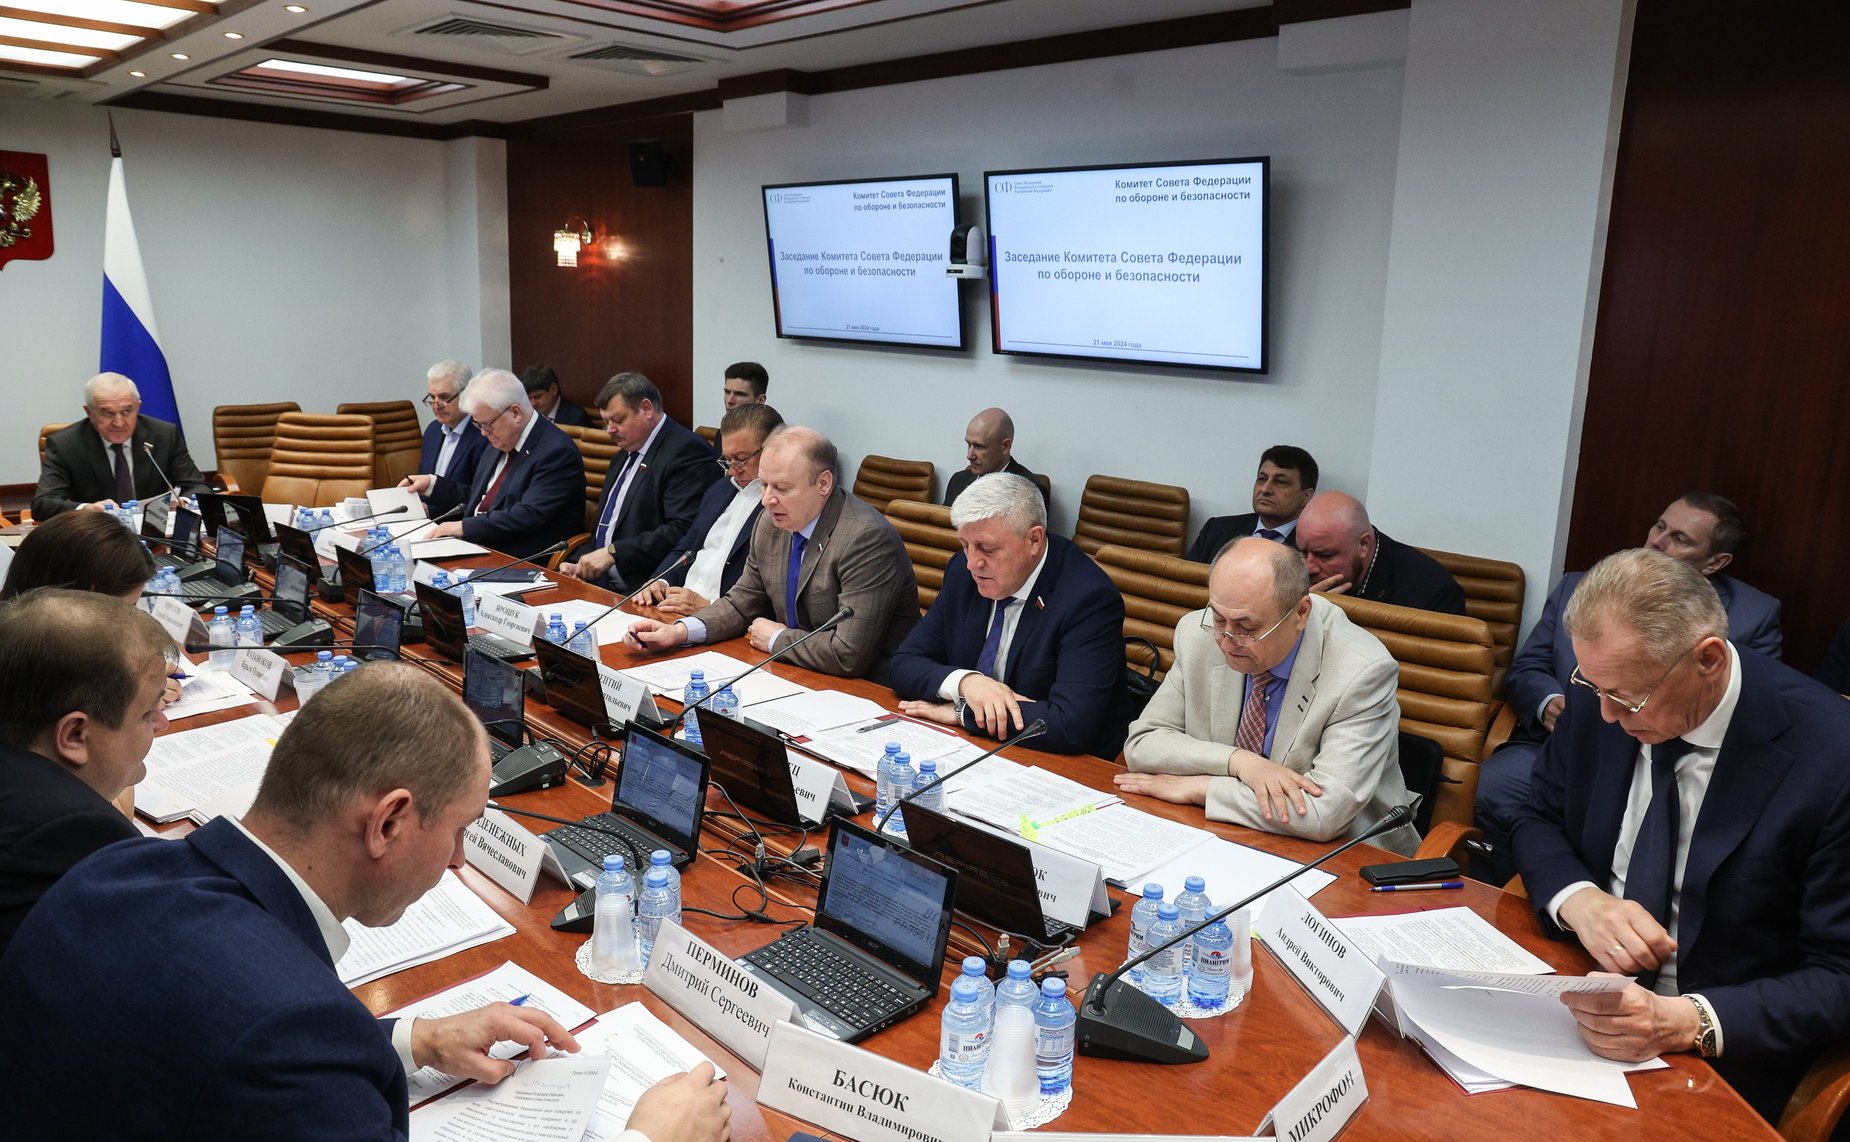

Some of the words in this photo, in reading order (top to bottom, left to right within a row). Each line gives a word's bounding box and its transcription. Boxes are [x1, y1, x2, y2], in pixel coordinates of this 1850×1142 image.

[853, 191, 879, 200] Комитет
[881, 190, 904, 198] Совета
[906, 189, 946, 198] Федерации
[1115, 179, 1153, 189] Комитет
[1155, 178, 1190, 188] Совета
[1193, 176, 1251, 187] Федерации
[1115, 195, 1127, 203] по
[1129, 193, 1169, 204] обороне
[1180, 191, 1251, 201] безопасности
[863, 203, 891, 212] обороне
[898, 201, 946, 210] безопасности
[780, 251, 819, 262] Заседание
[821, 251, 858, 261] Комитета
[860, 250, 890, 261] Совета
[892, 251, 943, 263] Федерации
[804, 267, 814, 275] по
[815, 265, 848, 277] обороне
[850, 267, 856, 275] и
[857, 265, 916, 276] безопасности
[1004, 251, 1061, 263] Заседание
[1063, 251, 1117, 263] Комитета
[1120, 251, 1164, 263] Совета
[1168, 252, 1242, 266] Федерации
[1038, 270, 1051, 279] по
[1054, 268, 1101, 282] обороне
[1105, 271, 1112, 280] и
[1115, 269, 1200, 283] безопасности
[599, 672, 623, 692] ЕПТИЙ
[475, 817, 528, 857] ЗДЕНЕЖНЫХ
[477, 836, 527, 880] Вячеславович
[1301, 911, 1347, 959] ЛОГИНОВ
[686, 940, 759, 998] ПЕРМИНОВ
[1275, 927, 1302, 957] Андрей
[1300, 951, 1345, 1002] Викторович
[660, 951, 710, 996] Дмитрий
[710, 986, 770, 1039] Сергеевич
[831, 1068, 910, 1113] БАСЮК
[1288, 1069, 1355, 1142] МИКРОФОН
[787, 1076, 854, 1114] Константин
[856, 1104, 946, 1142] Владимирови
